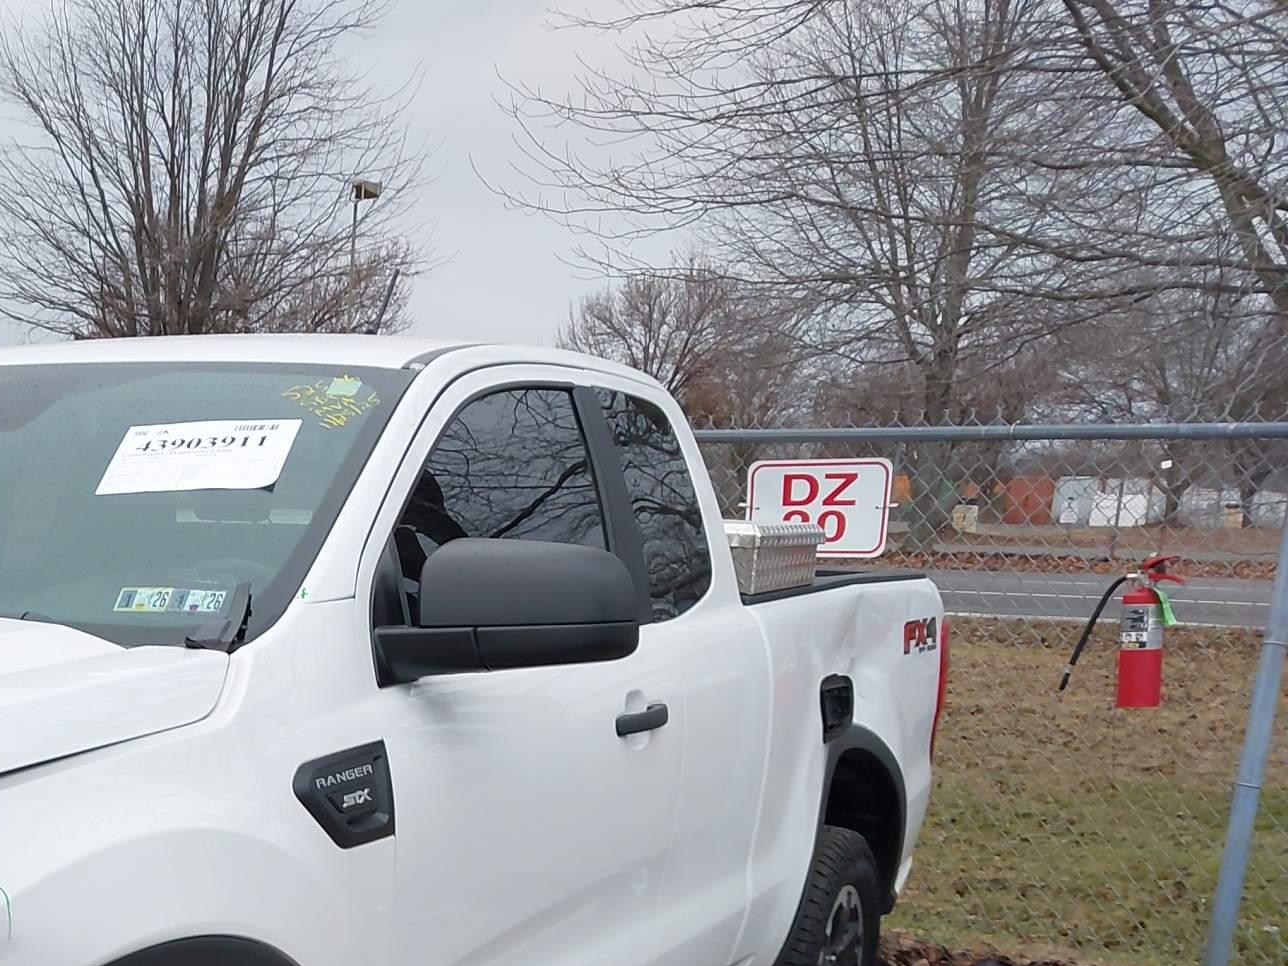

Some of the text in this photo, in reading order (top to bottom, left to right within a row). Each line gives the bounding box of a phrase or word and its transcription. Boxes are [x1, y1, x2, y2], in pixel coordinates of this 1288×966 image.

[136, 435, 268, 452] 43903911
[782, 472, 859, 506] DZ
[152, 591, 170, 608] 26
[206, 592, 224, 610] 26
[903, 616, 937, 655] FX4
[315, 763, 373, 789] RANGER
[342, 787, 373, 808] STX
